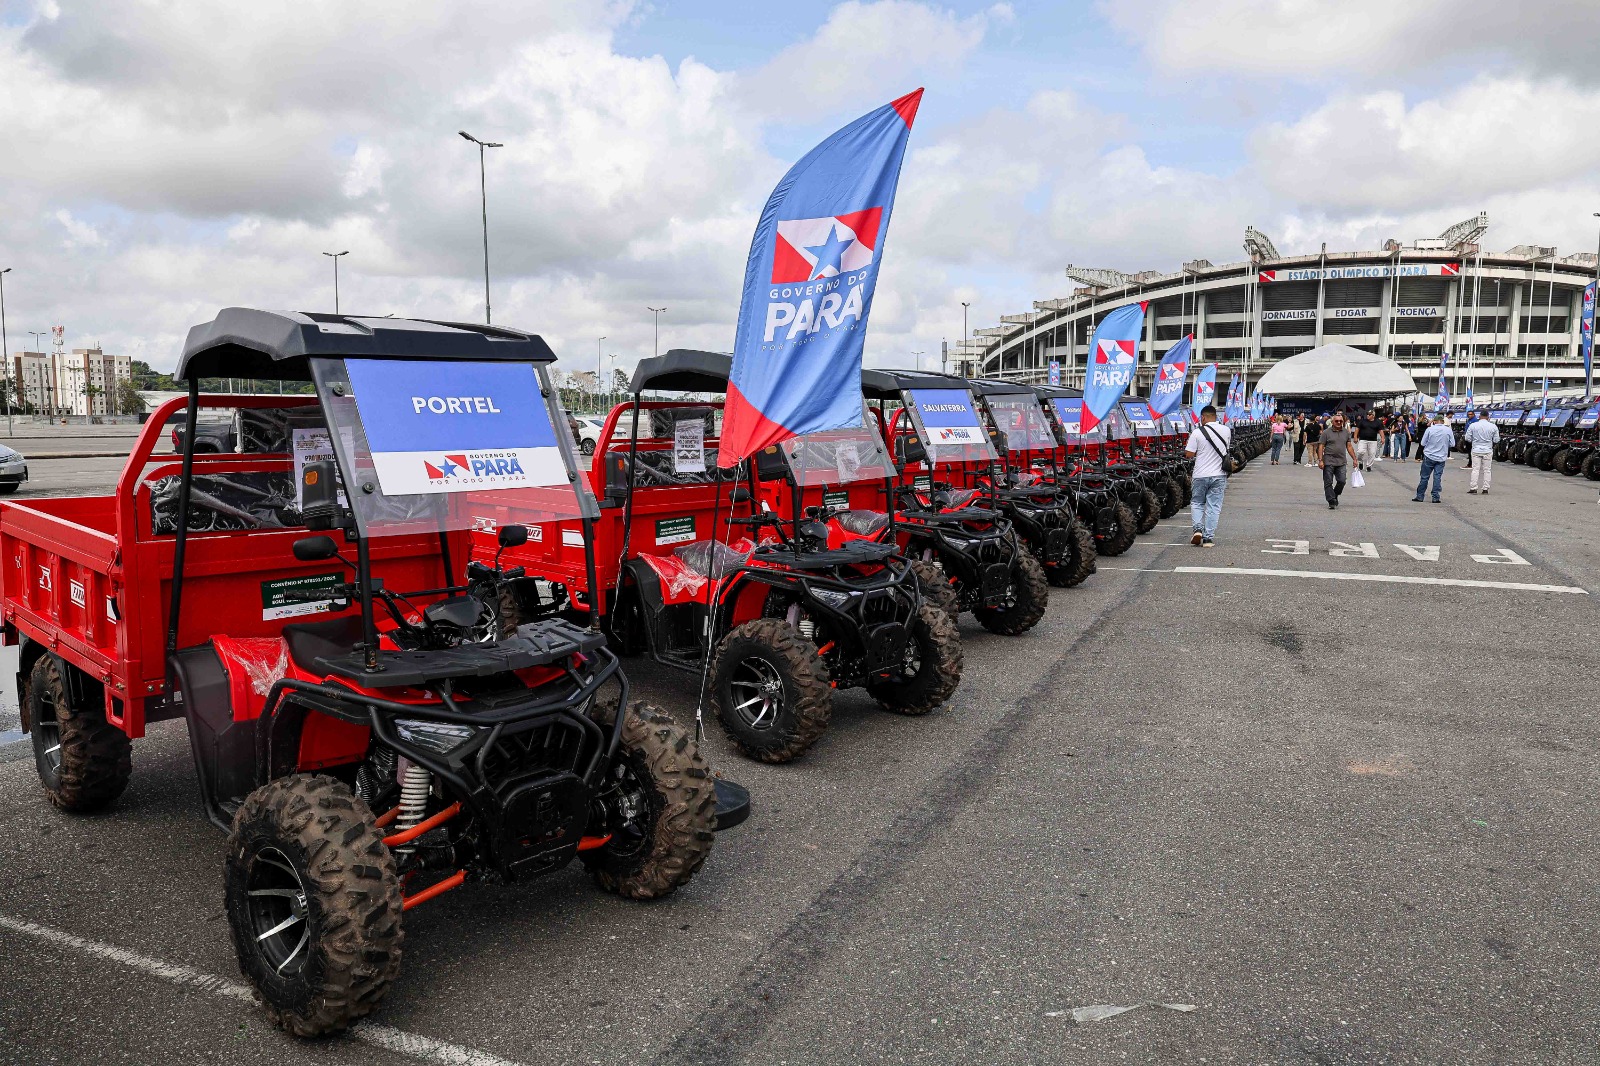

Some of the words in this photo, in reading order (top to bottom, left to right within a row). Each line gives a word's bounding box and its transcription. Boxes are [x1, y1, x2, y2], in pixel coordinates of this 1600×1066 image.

[1288, 269, 1327, 280] ESTÁDIO
[1330, 267, 1380, 278] OLÍMPICO
[1382, 267, 1397, 277] DO
[1400, 265, 1428, 276] PARÁ
[769, 278, 840, 299] GOVERNO
[847, 270, 868, 286] DO
[763, 282, 865, 342] PARÁ
[1263, 310, 1316, 320] JORNALISTA
[1335, 309, 1367, 317] EDGAR
[1396, 308, 1437, 317] PROENÇA
[412, 396, 501, 414] PORTEL
[922, 403, 967, 412] SALVATERRA
[1260, 538, 1533, 566] PARE
